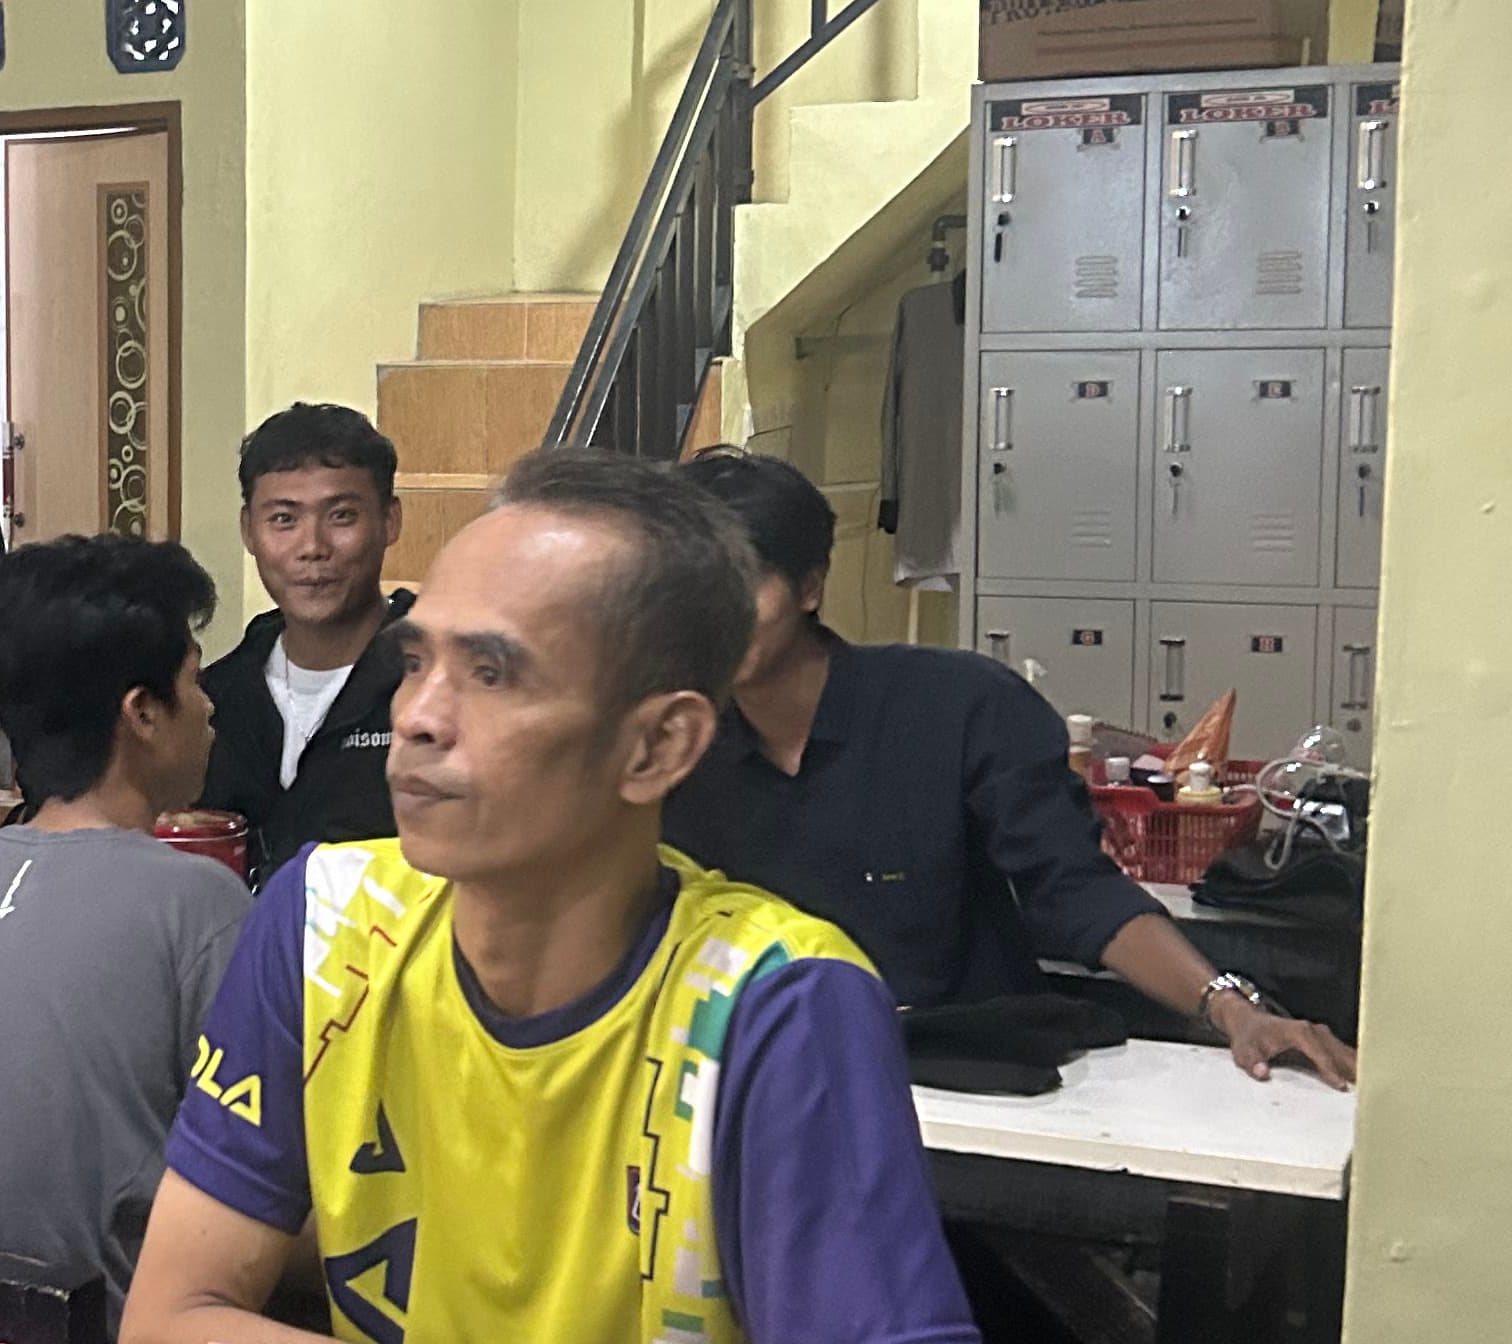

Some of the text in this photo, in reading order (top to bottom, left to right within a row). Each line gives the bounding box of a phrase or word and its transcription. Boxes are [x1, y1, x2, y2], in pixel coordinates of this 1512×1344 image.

[1001, 111, 1131, 130] LOKER
[1180, 103, 1317, 123] LOKER
[1090, 128, 1107, 144] A
